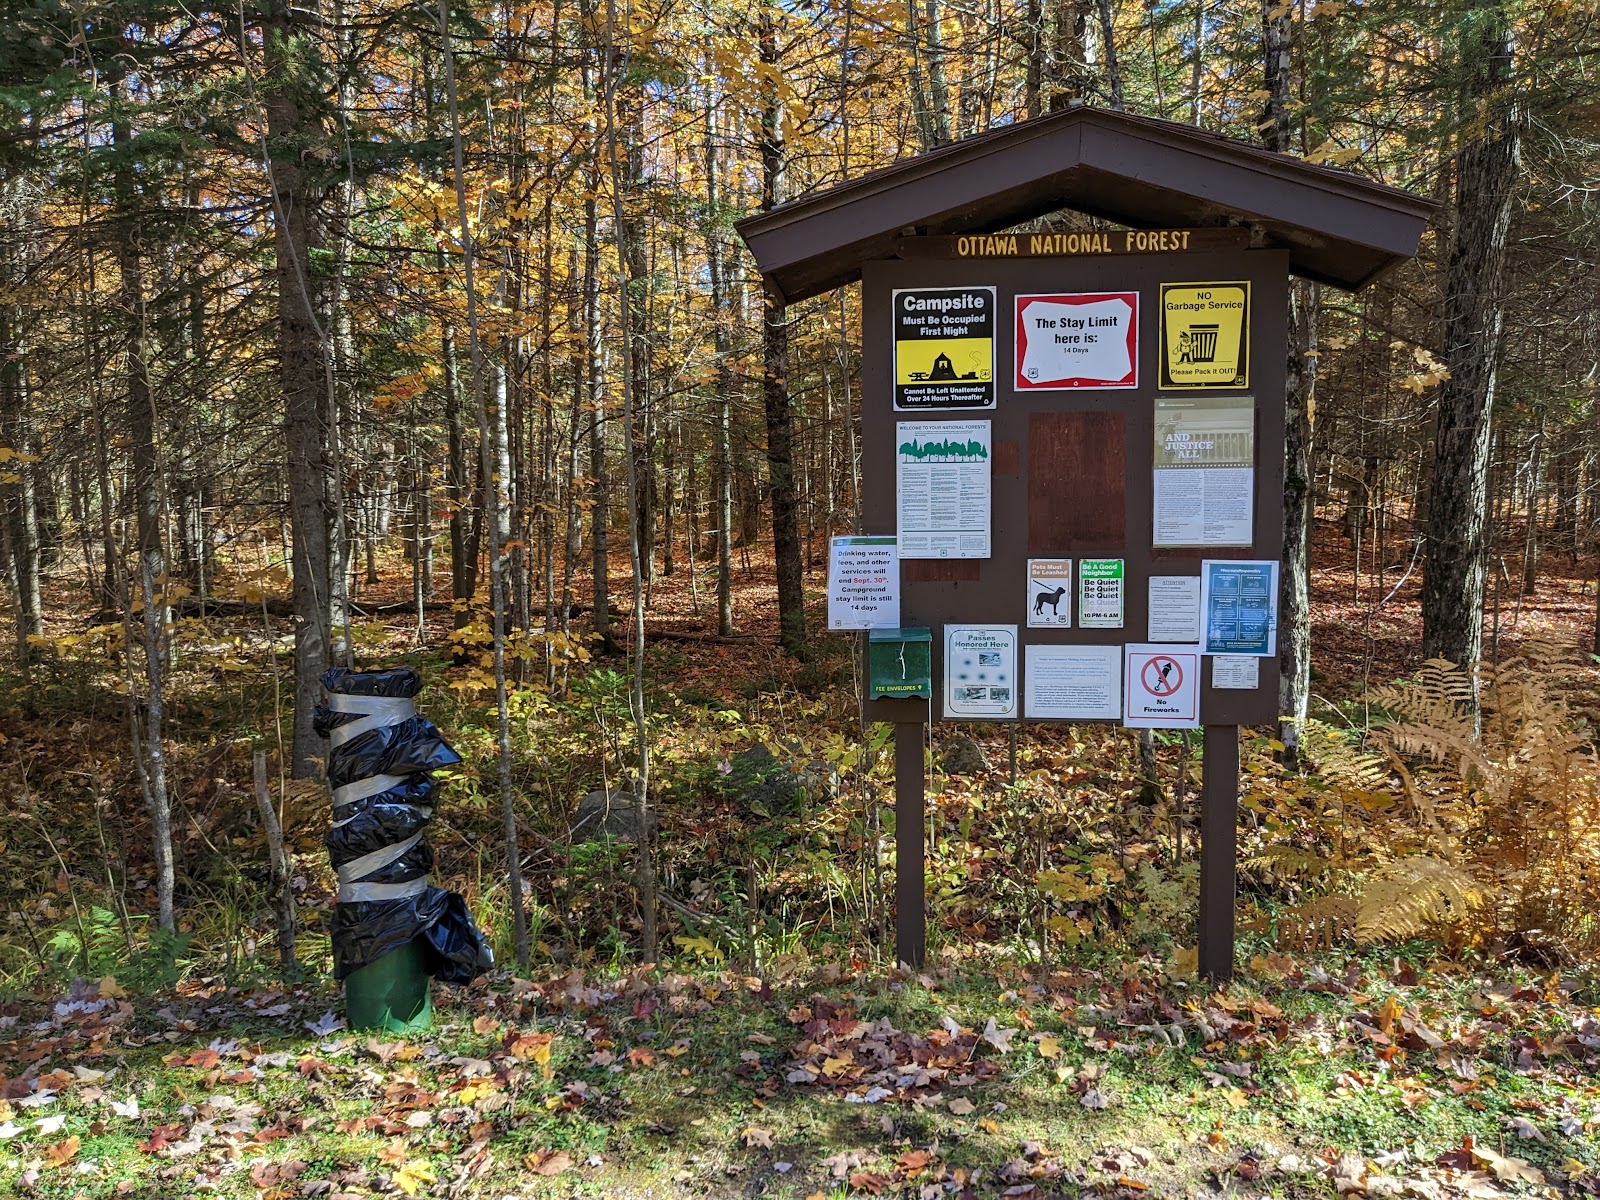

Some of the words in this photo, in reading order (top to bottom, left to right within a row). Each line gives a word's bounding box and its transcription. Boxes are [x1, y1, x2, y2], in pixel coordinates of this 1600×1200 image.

[957, 236, 1018, 256] OTTAWA
[1030, 233, 1112, 255] NATIONAL
[1126, 231, 1190, 252] FOREST
[1197, 292, 1212, 300] NO
[903, 293, 985, 313] Campsite
[1166, 302, 1206, 312] Garbage
[1208, 301, 1243, 309] Service
[902, 316, 926, 325] Must
[928, 316, 940, 325] Be
[942, 314, 986, 325] Occupied
[1035, 318, 1057, 329] The
[1059, 317, 1085, 330] Stay
[1088, 316, 1118, 328] Limit
[920, 327, 941, 336] First
[943, 326, 968, 336] Night
[1054, 333, 1080, 344] here
[1084, 333, 1098, 343] is:
[949, 386, 986, 394] Unattended
[1165, 433, 1190, 442] AND
[1164, 441, 1214, 451] JUSTICE
[1177, 450, 1200, 459] ALL
